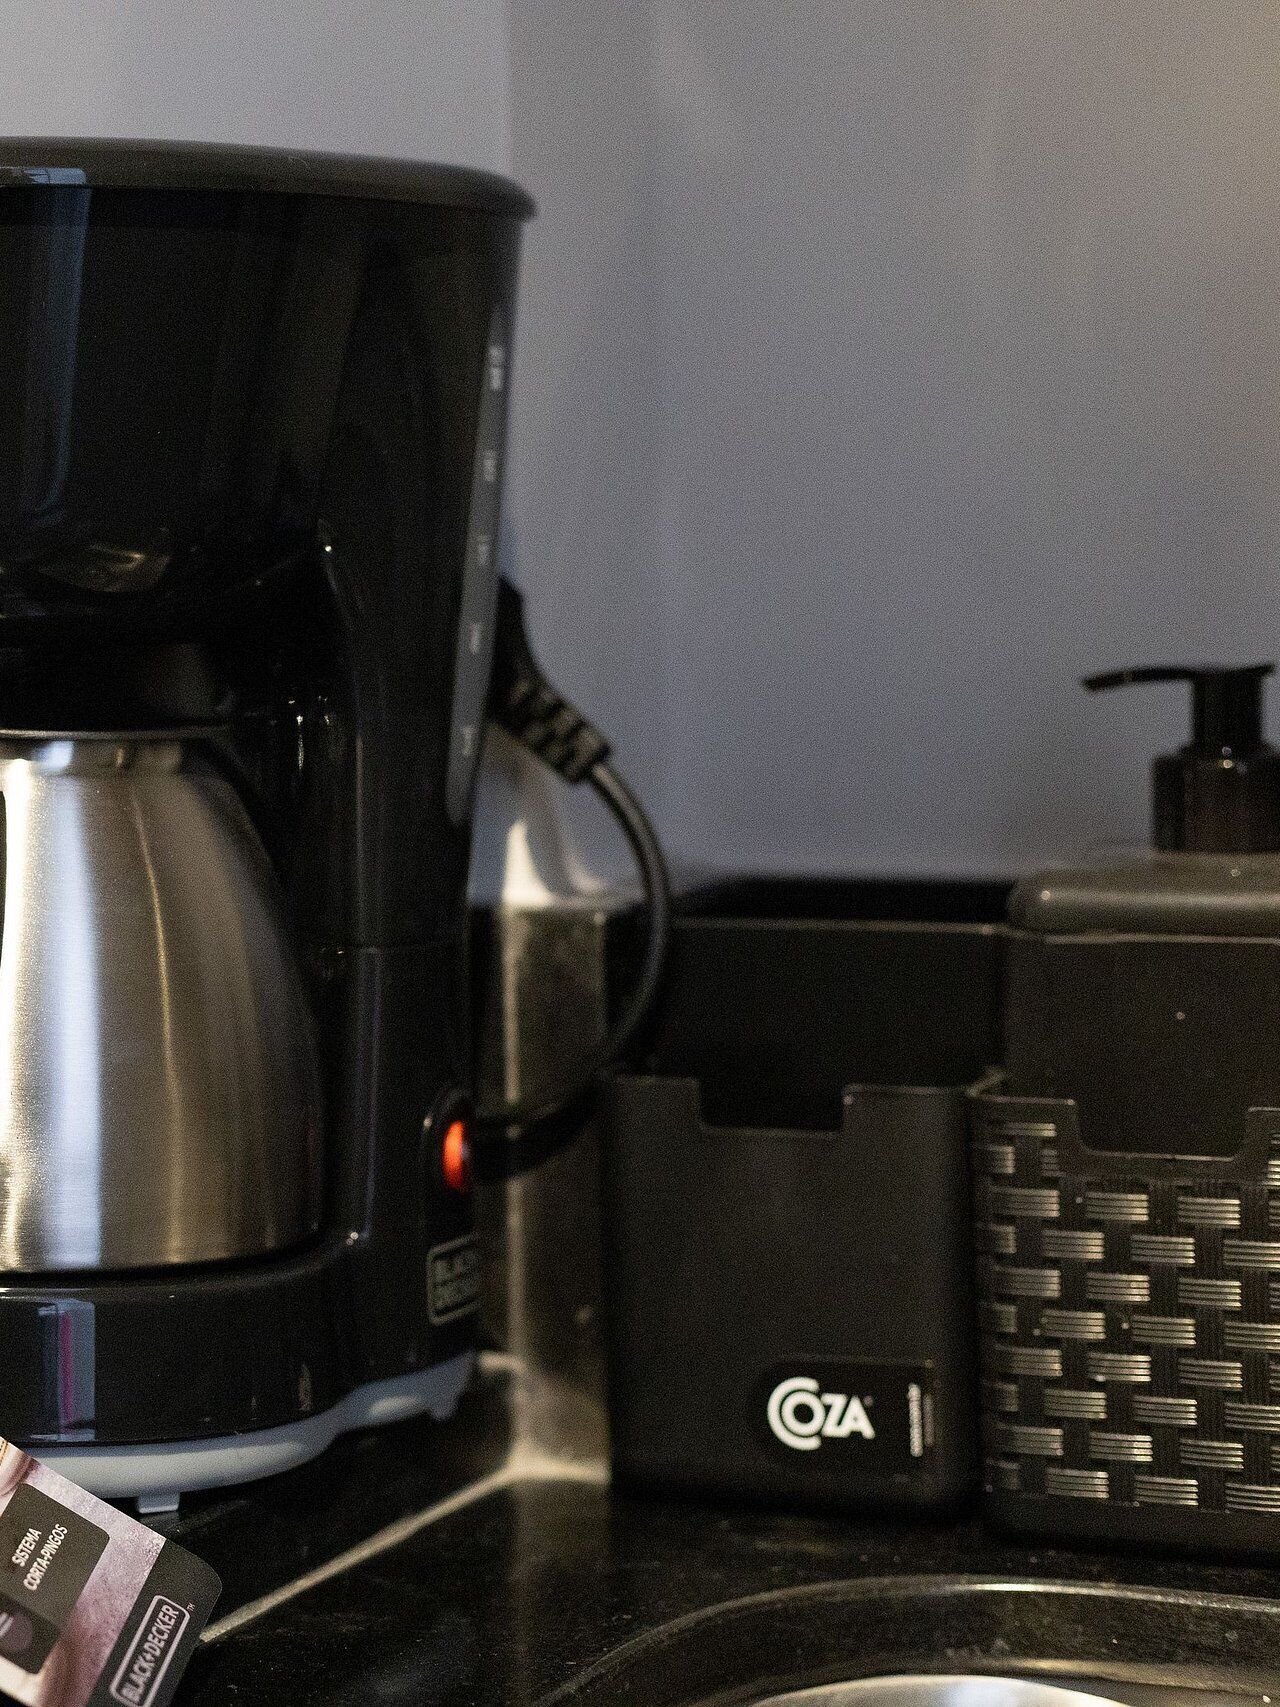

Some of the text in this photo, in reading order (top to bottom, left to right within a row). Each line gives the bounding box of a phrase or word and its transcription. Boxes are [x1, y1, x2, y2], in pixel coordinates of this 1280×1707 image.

[767, 1376, 875, 1450] COZA
[11, 1528, 42, 1567] SISTEMA
[23, 1523, 68, 1591] CORTA-PINGOS
[120, 1604, 179, 1704] BLACK+DECKER
